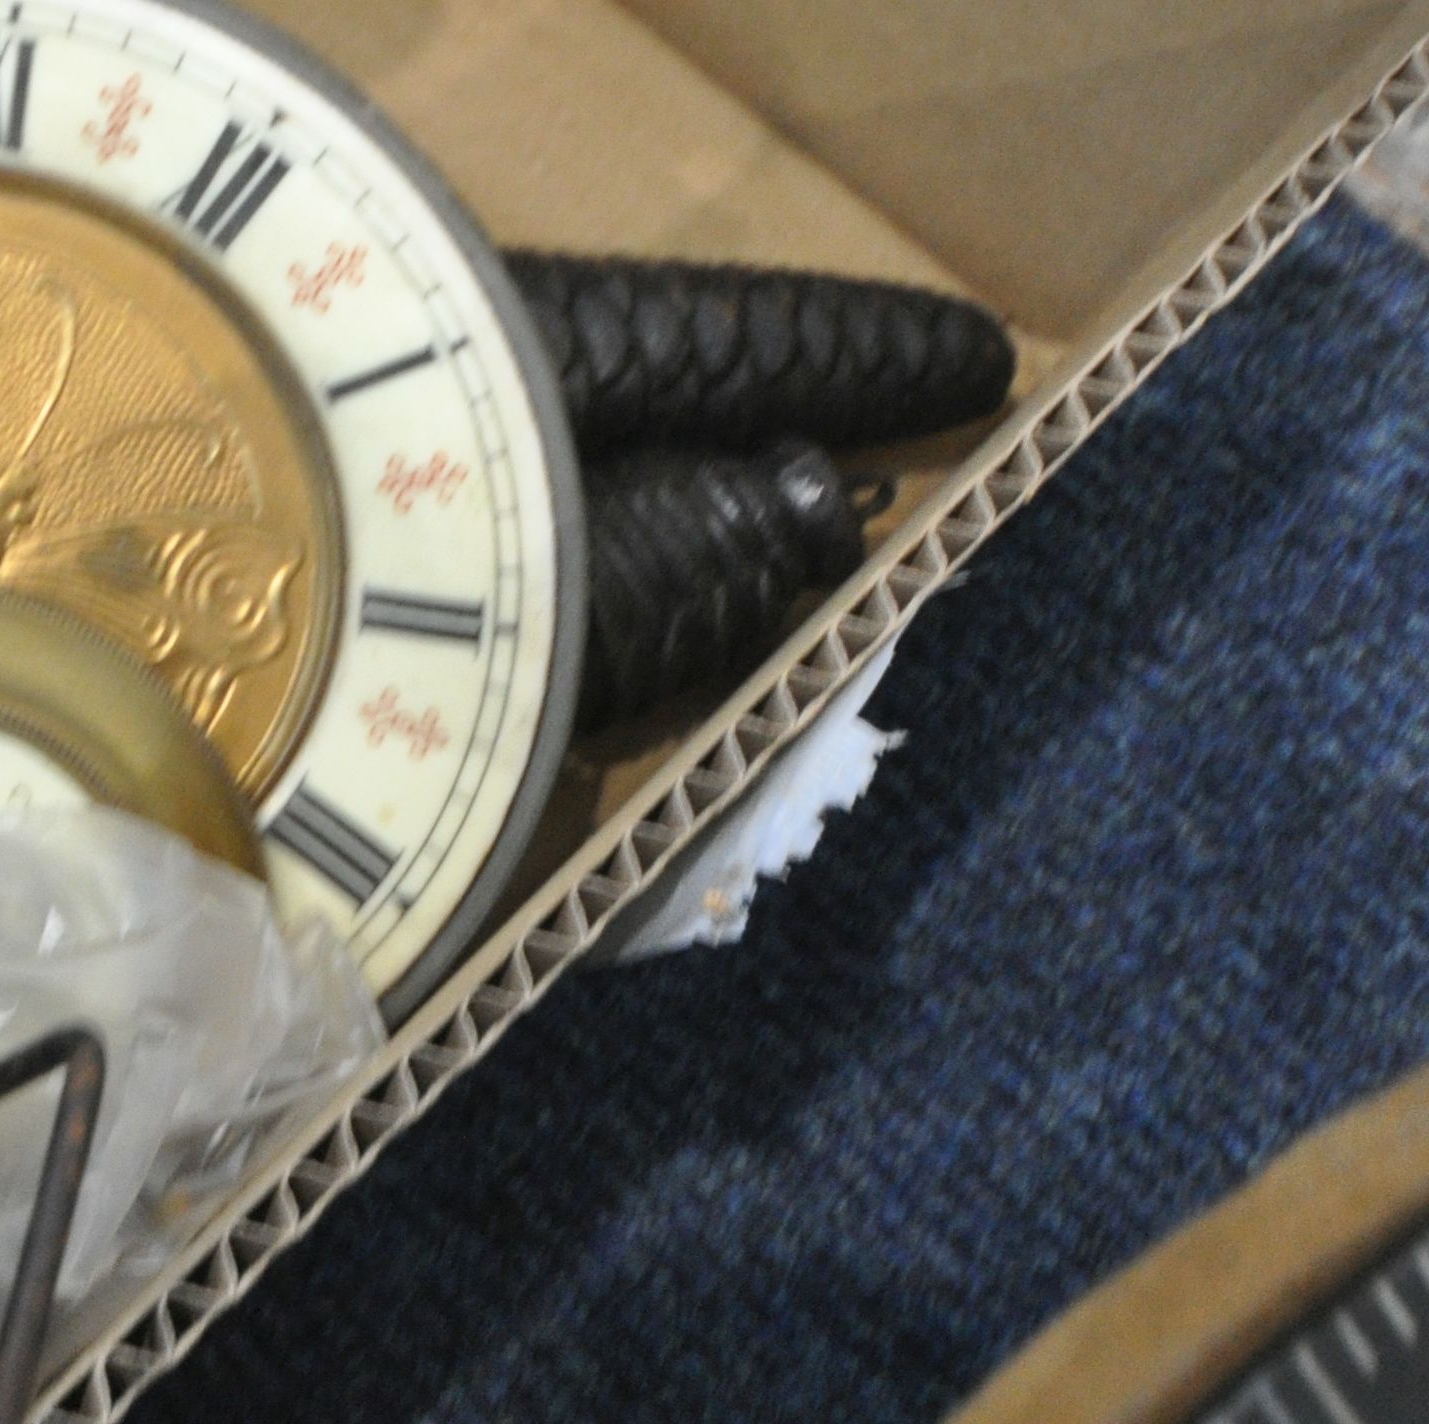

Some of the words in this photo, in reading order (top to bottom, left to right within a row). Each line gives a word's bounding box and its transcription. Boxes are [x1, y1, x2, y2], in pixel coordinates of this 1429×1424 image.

[159, 118, 291, 252] XII
[324, 347, 438, 408] I
[358, 582, 486, 661] II
[256, 774, 406, 916] III
